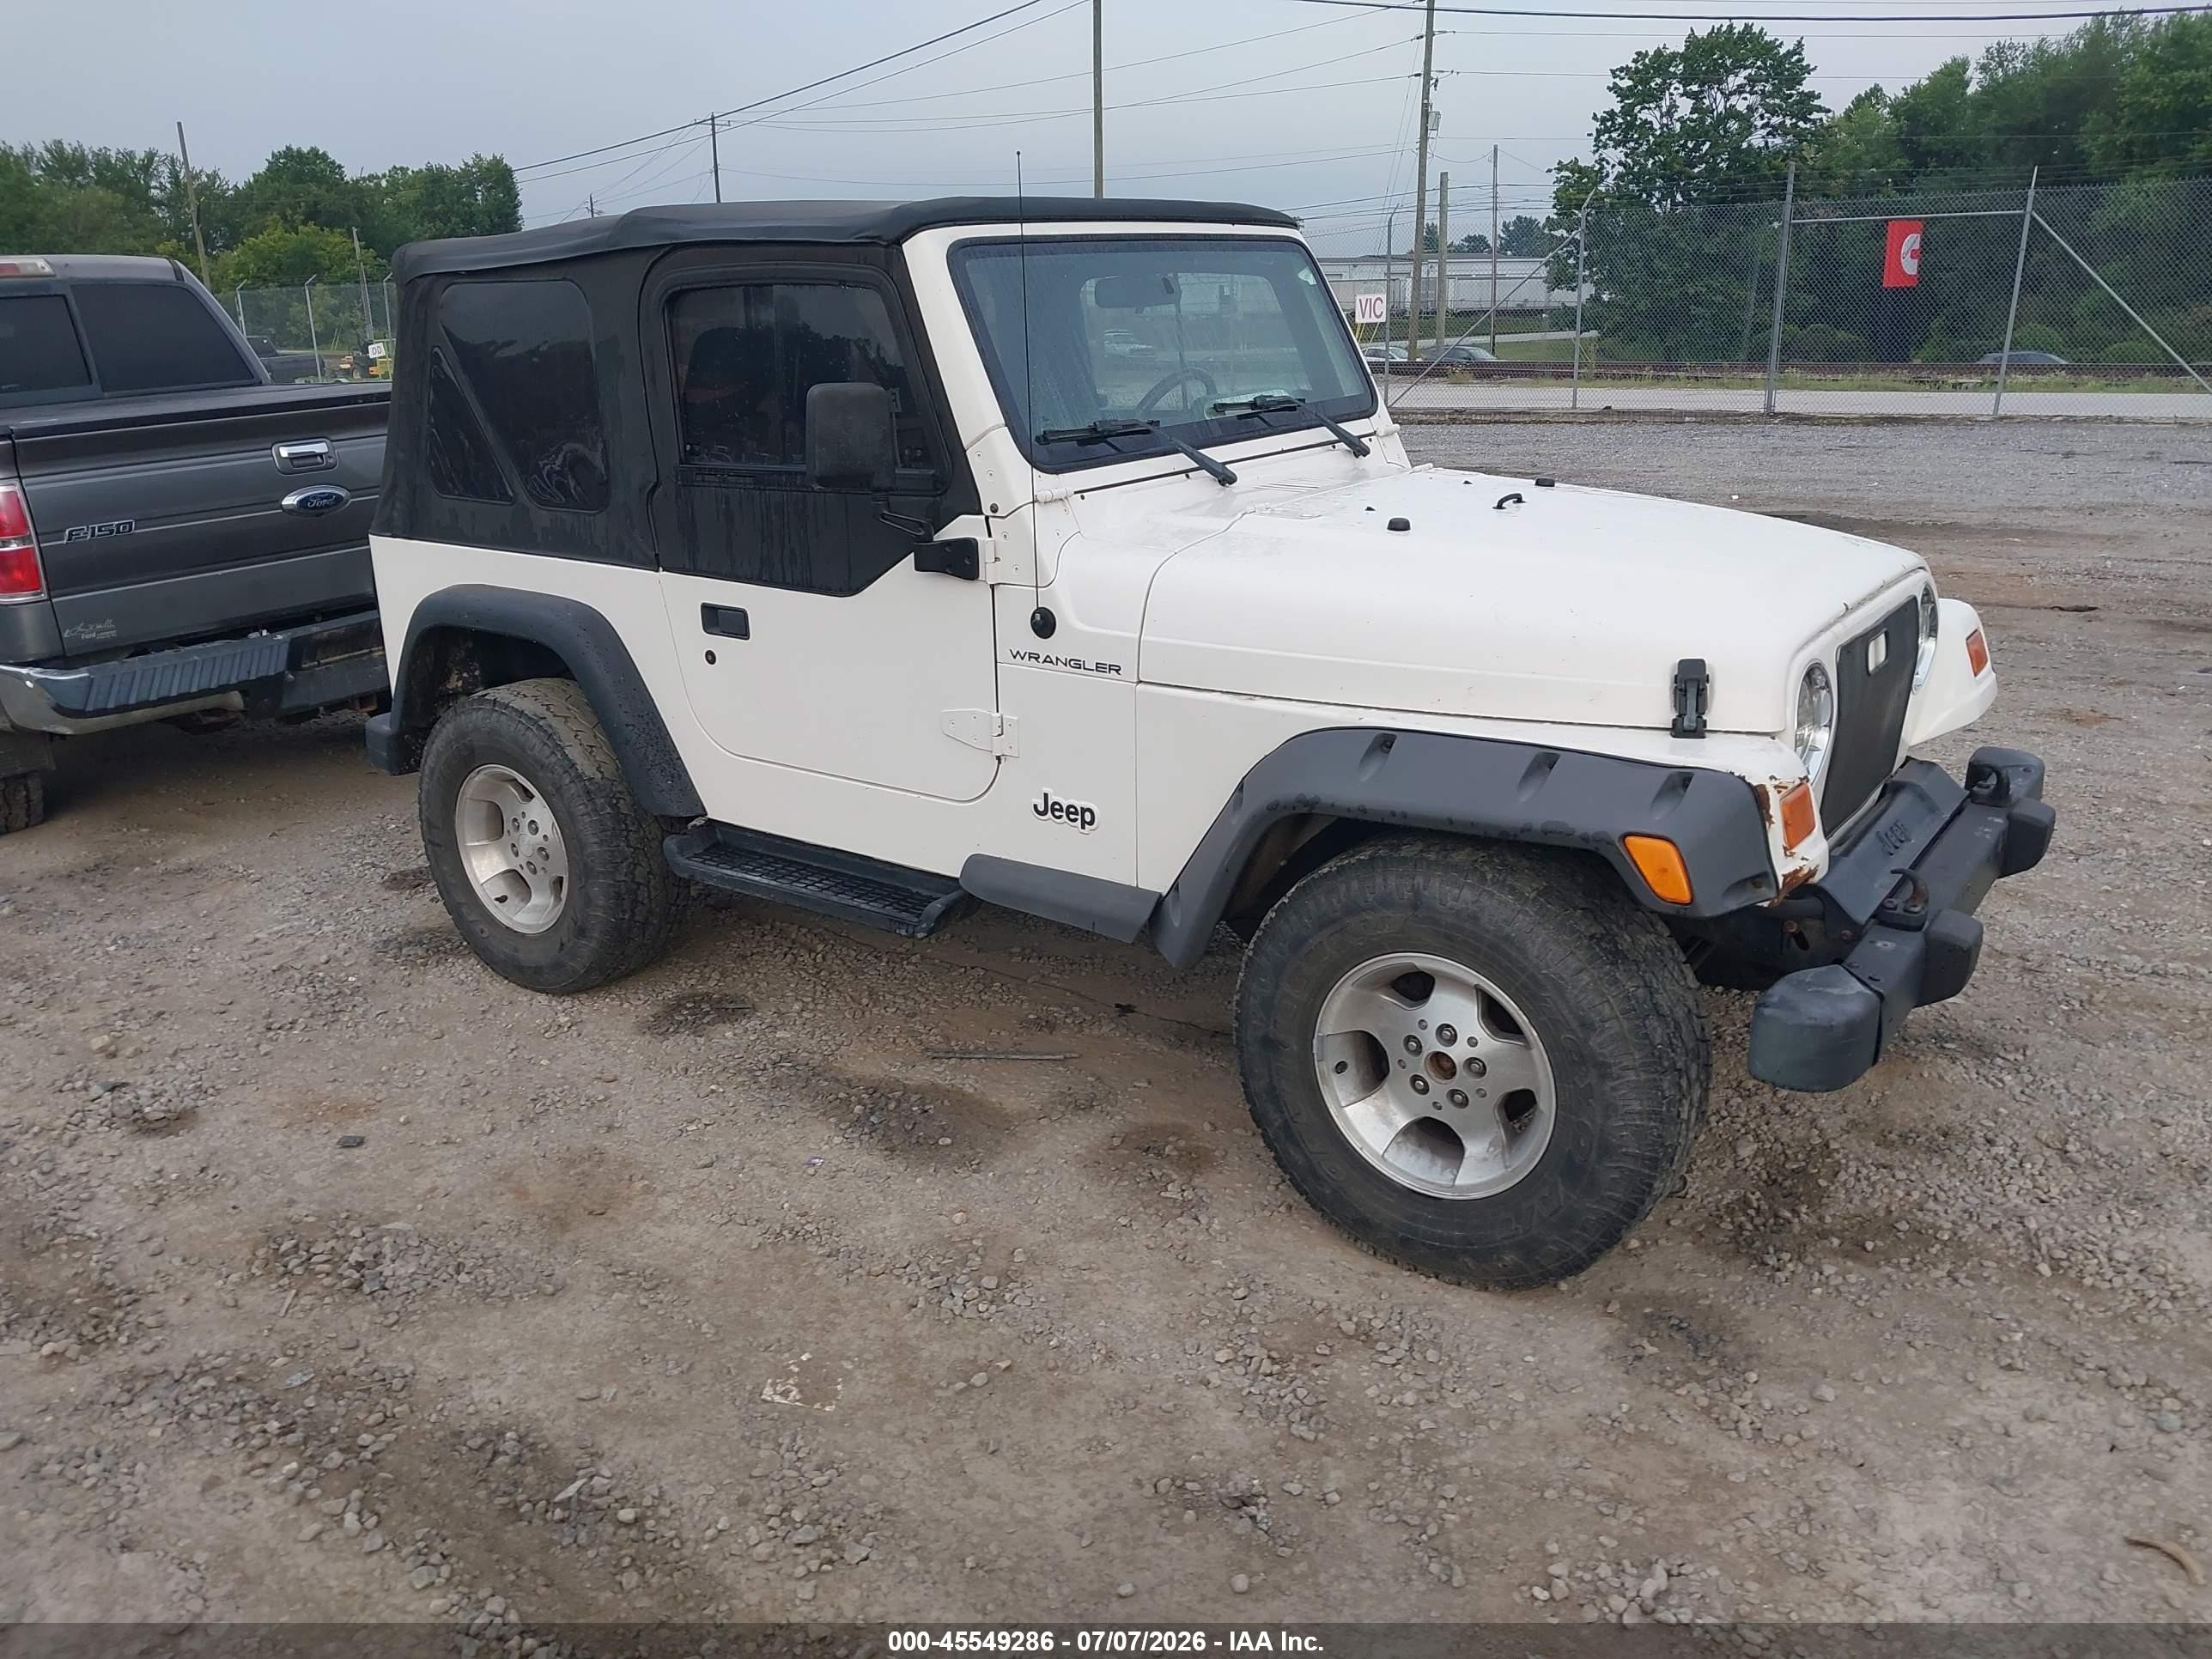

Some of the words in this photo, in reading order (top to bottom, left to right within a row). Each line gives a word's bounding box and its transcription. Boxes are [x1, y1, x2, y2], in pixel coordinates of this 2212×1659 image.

[1358, 296, 1383, 319] VIC
[307, 493, 337, 507] Ford
[64, 519, 135, 544] F-150
[1009, 648, 1122, 675] WRANGLER
[1032, 791, 1097, 830] Jeep
